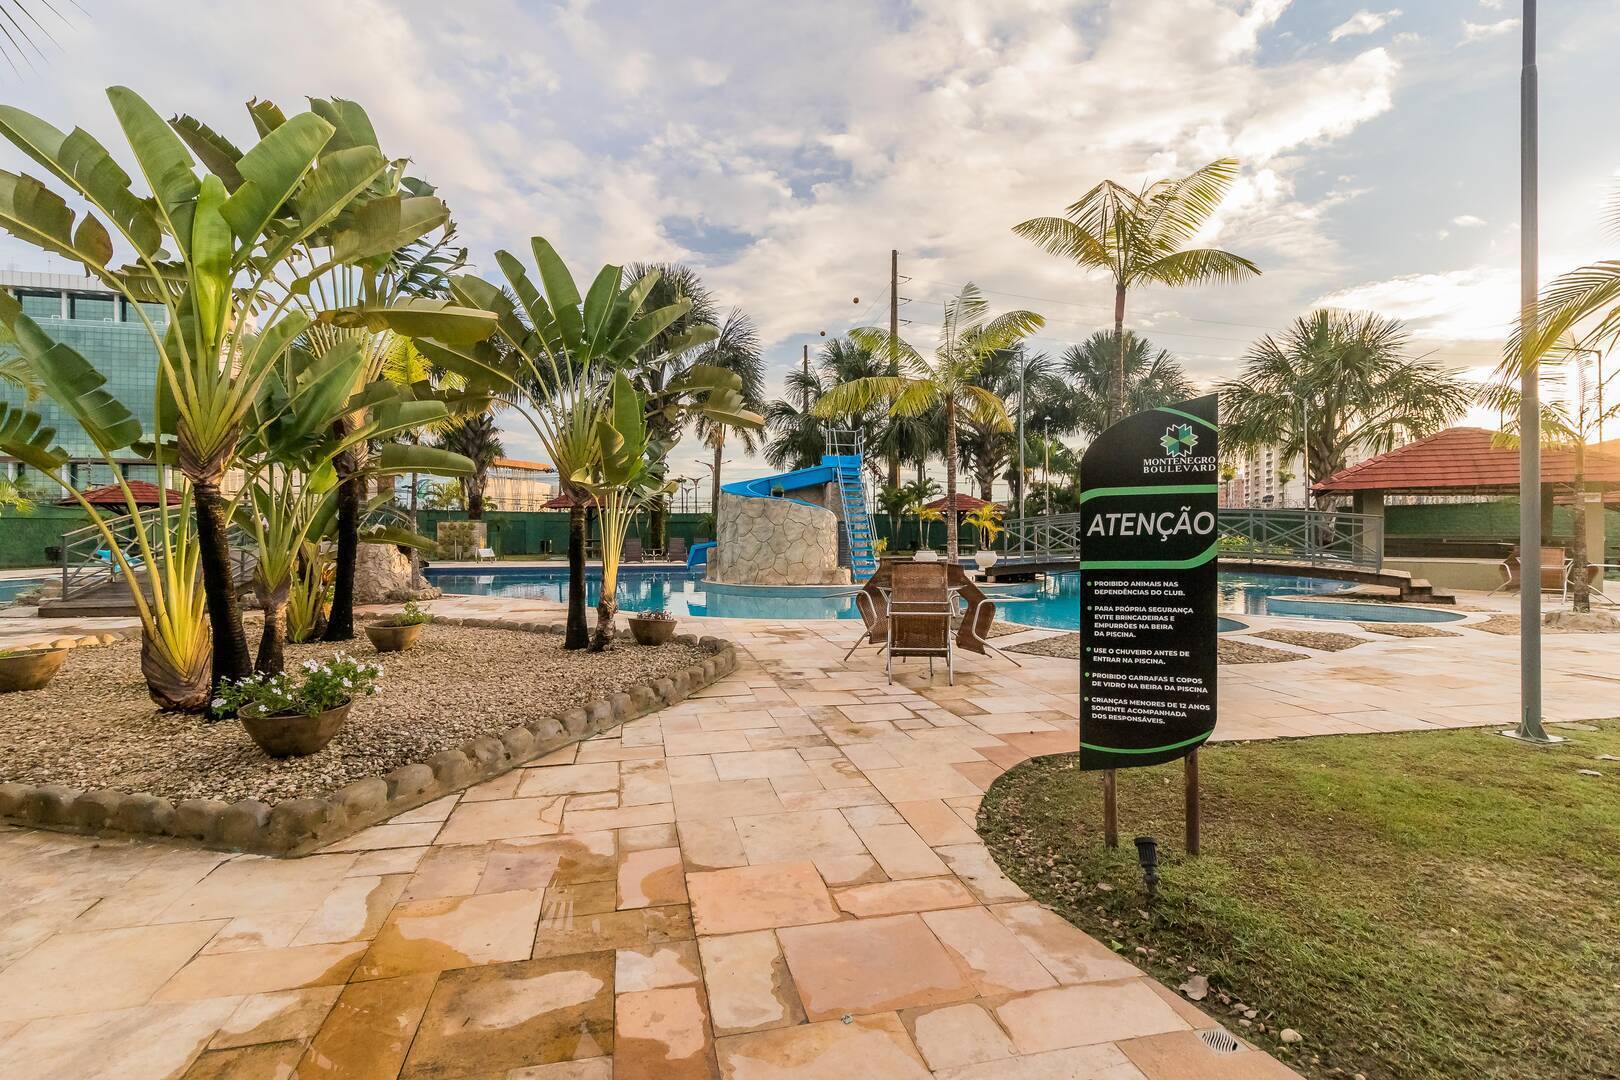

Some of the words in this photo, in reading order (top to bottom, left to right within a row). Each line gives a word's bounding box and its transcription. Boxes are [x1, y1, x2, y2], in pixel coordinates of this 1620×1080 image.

[1144, 456, 1216, 466] MONTENEGRO
[1144, 464, 1216, 473] BOULEVARD
[1087, 506, 1215, 542] ATENÇÃO
[1127, 708, 1186, 717] ACOMPANHADA
[1109, 714, 1165, 724] RESPONSÁVEIS.
